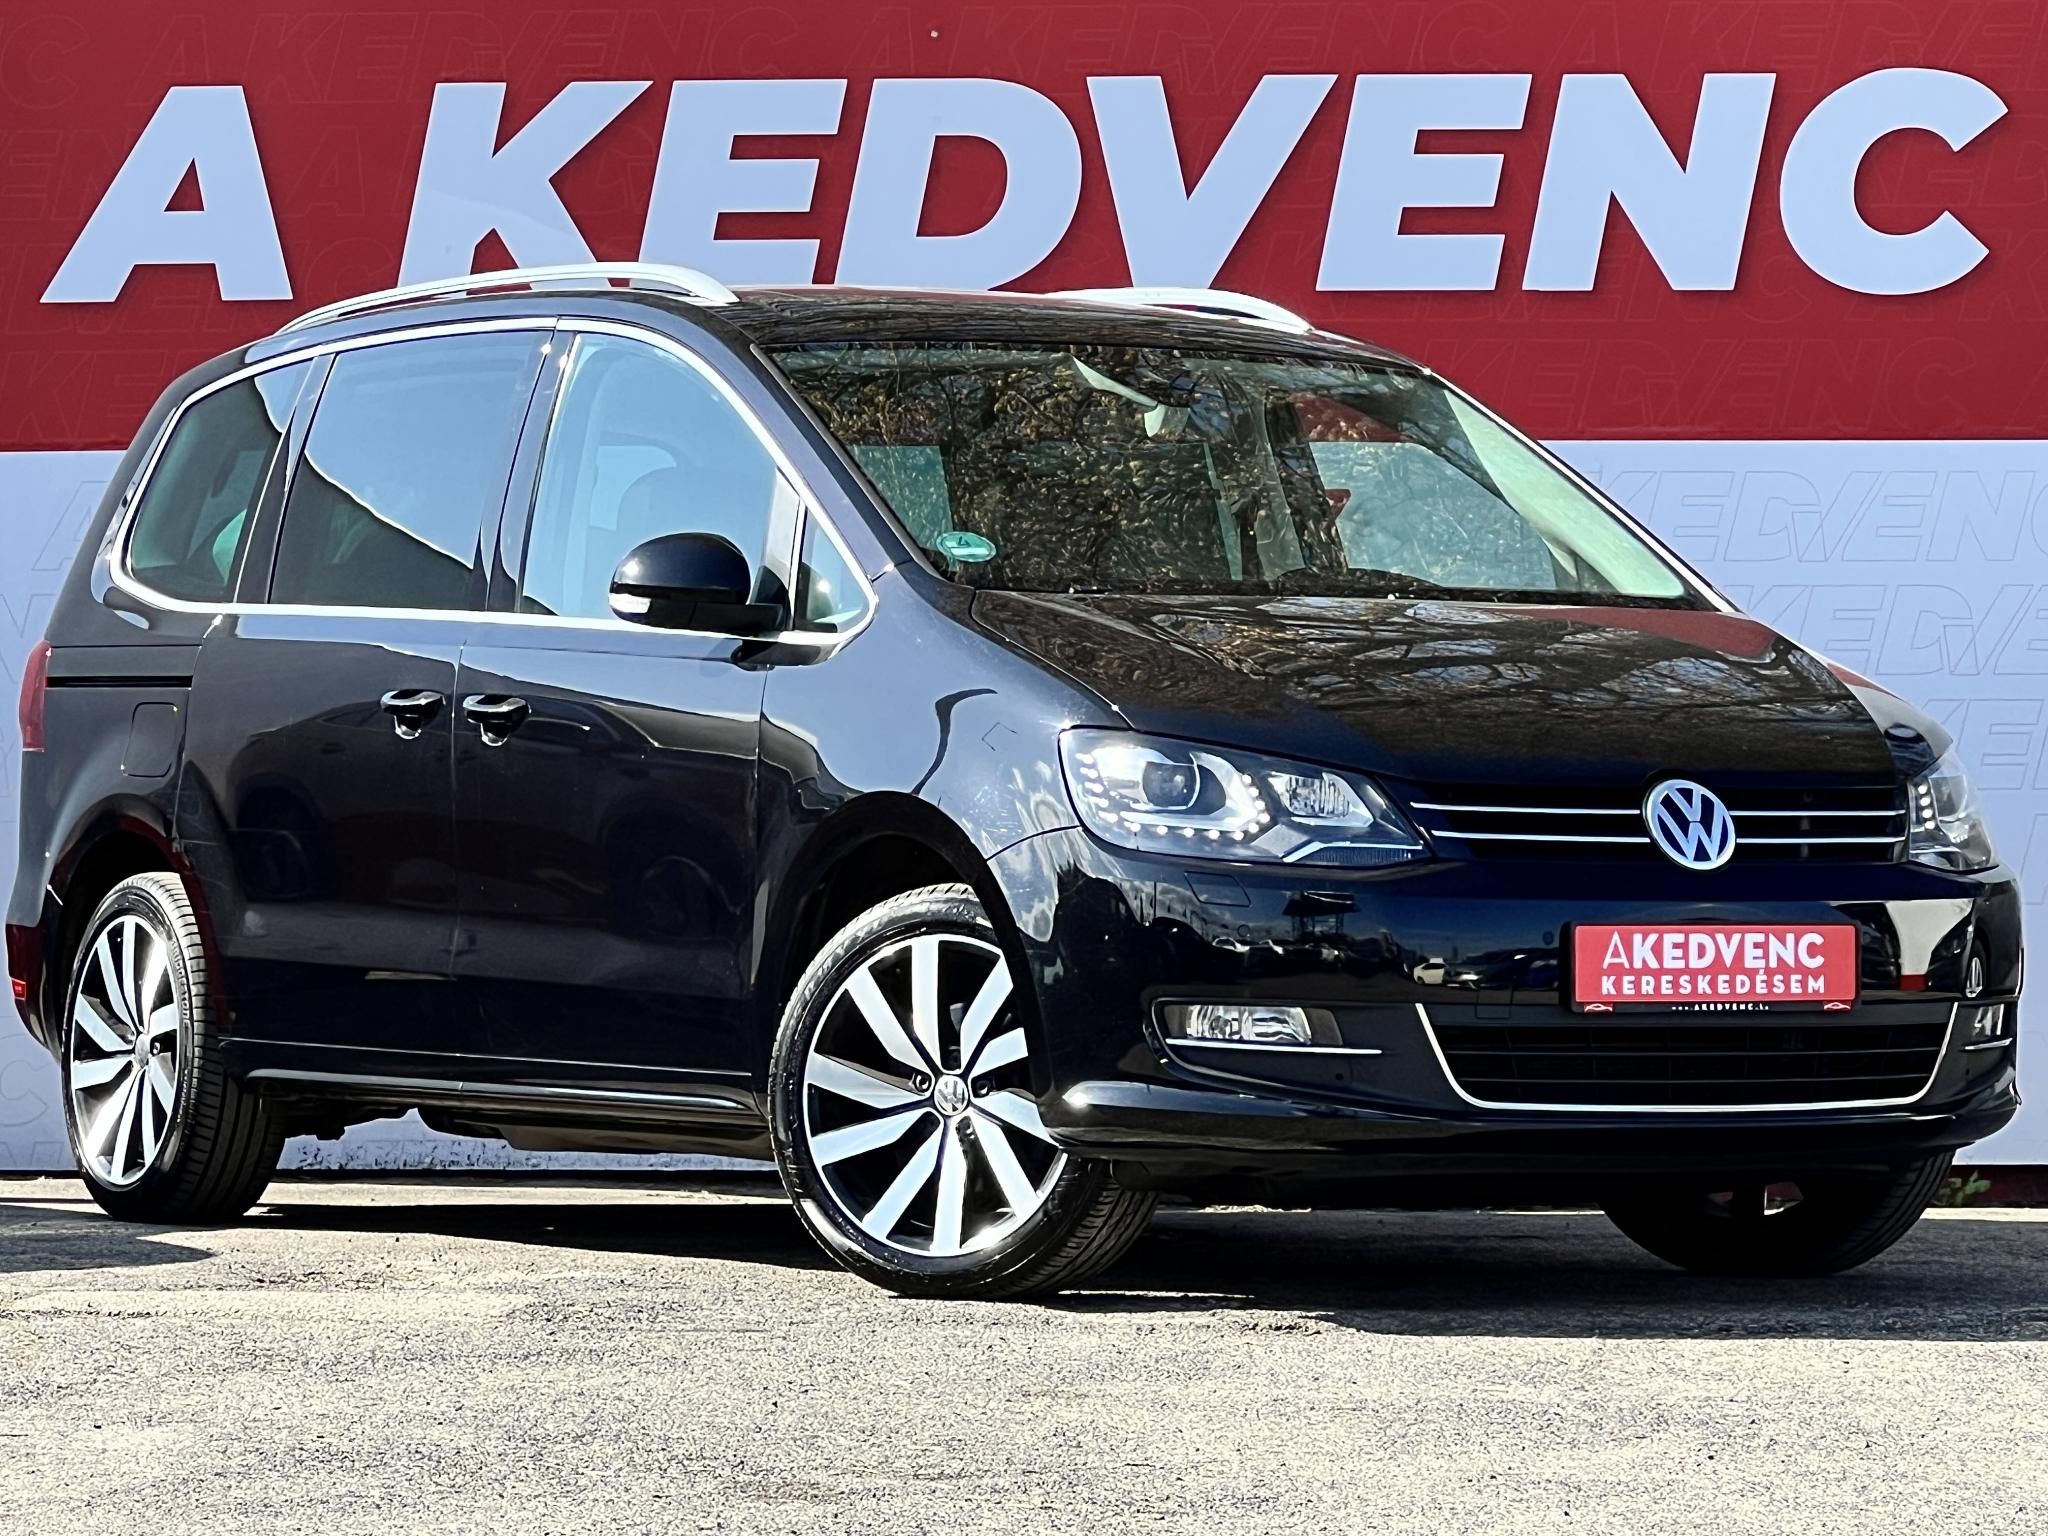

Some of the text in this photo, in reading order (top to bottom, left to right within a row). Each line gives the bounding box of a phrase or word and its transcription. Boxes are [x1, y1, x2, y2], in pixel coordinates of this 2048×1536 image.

[40, 86, 293, 303] A
[397, 68, 2008, 295] KEDVENC
[1602, 931, 1825, 970] AKEDVENC
[1601, 969, 1825, 995] KERESKEDÉSEM
